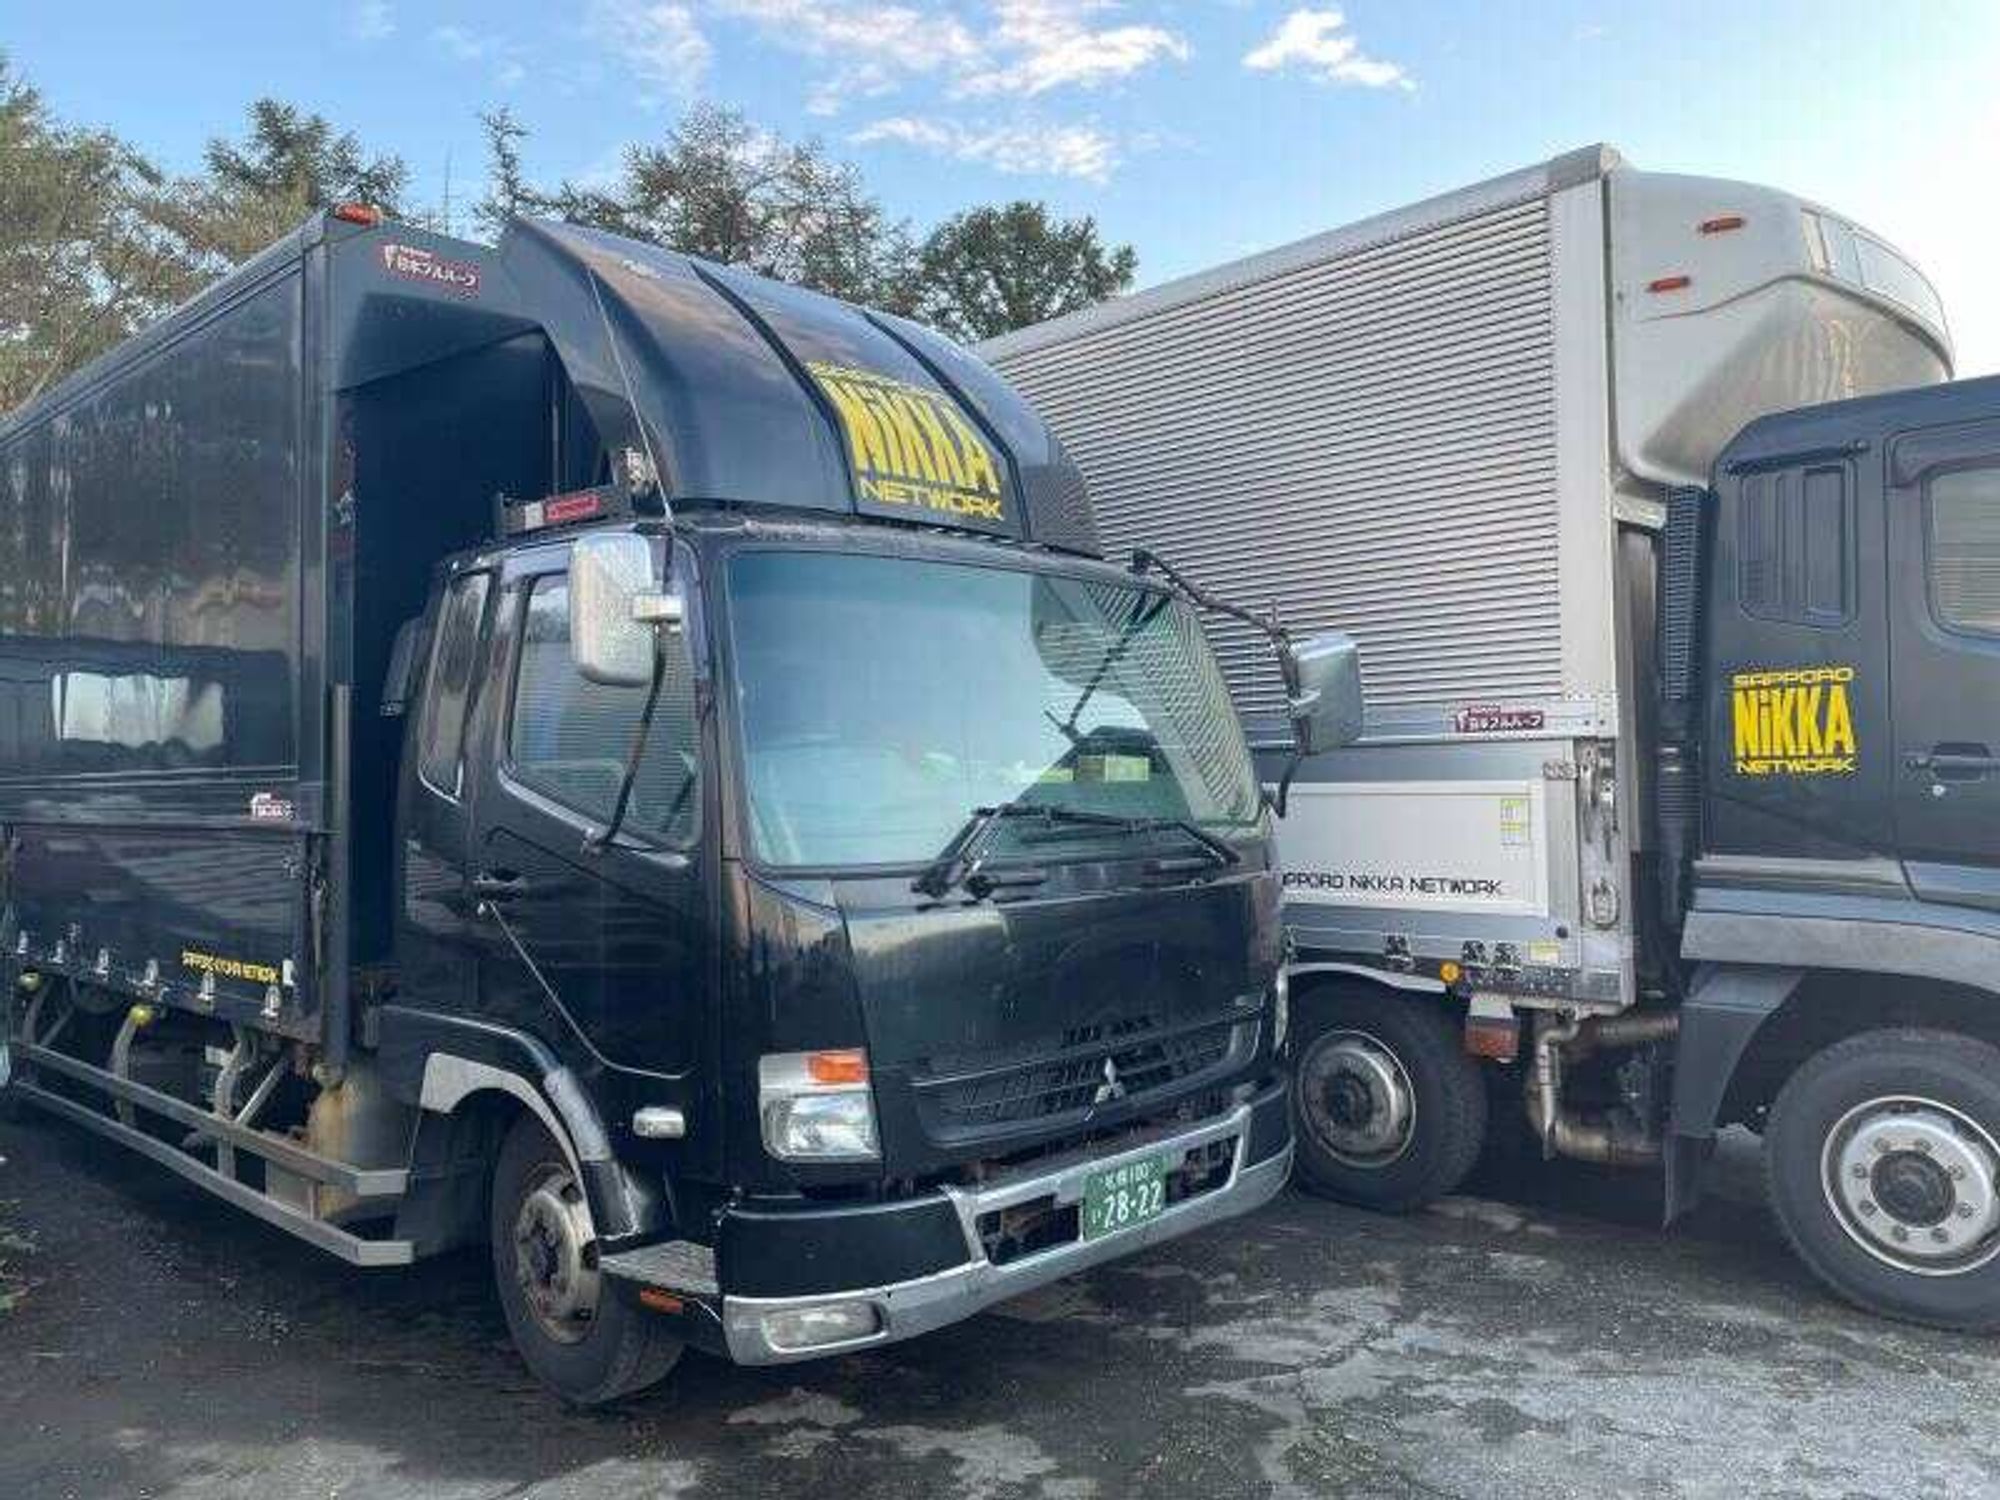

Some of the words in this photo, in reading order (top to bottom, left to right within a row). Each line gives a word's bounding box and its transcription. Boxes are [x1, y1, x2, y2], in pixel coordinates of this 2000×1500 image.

[857, 478, 1004, 521] NETWORK
[1733, 667, 1853, 687] SAPPORO
[1736, 757, 1855, 774] NETWORK
[1410, 876, 1500, 894] NETWORK
